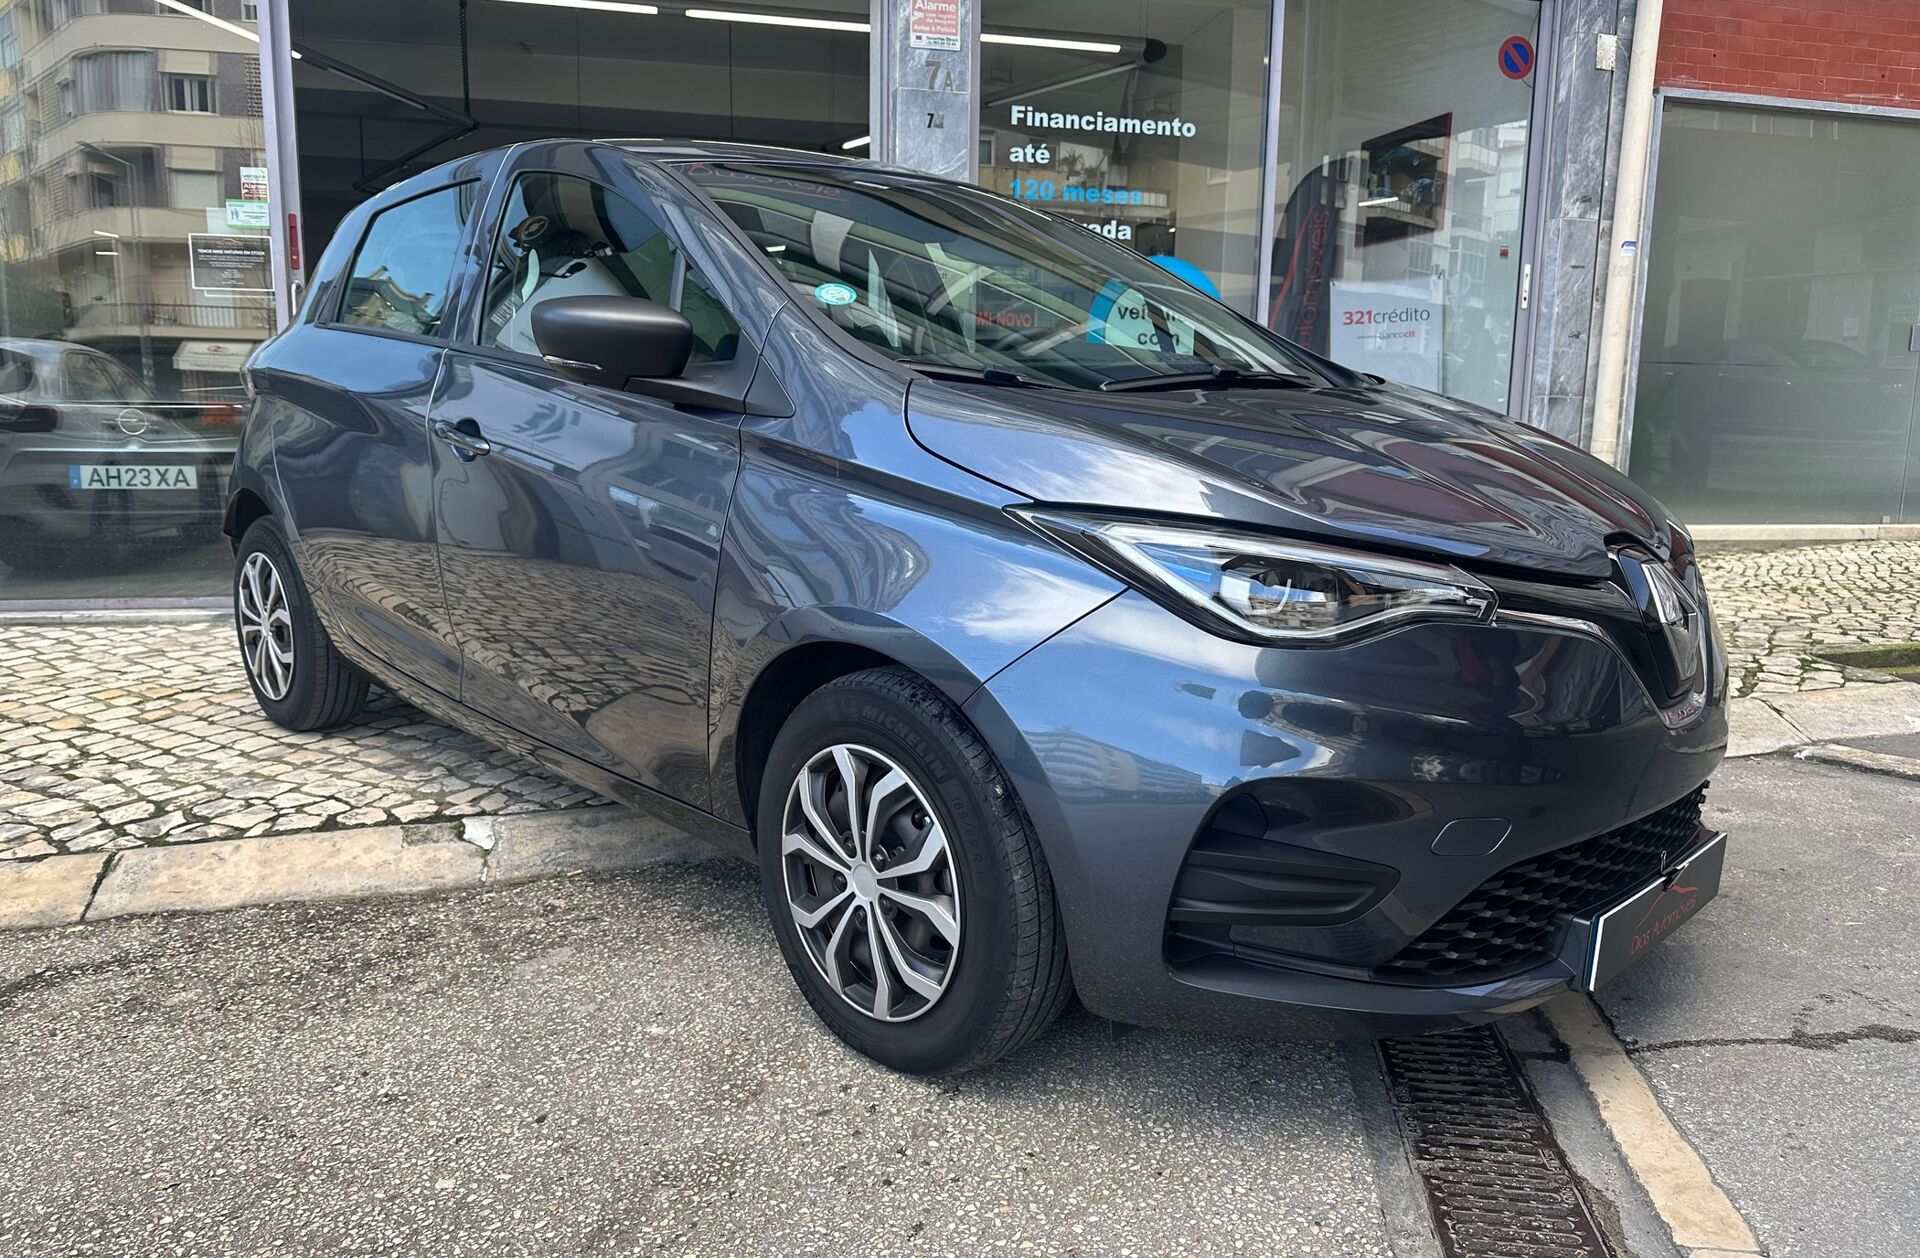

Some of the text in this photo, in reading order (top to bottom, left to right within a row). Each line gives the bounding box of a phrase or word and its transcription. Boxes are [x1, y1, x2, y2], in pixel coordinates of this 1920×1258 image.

[915, 0, 957, 12] Alarme
[1010, 104, 1197, 138] Financiamento
[1009, 144, 1050, 164] até
[1009, 177, 1143, 206] 120 meses
[997, 312, 1033, 328] NOVO
[1343, 308, 1431, 326] 321crédito
[861, 704, 951, 782] MICHELIN
